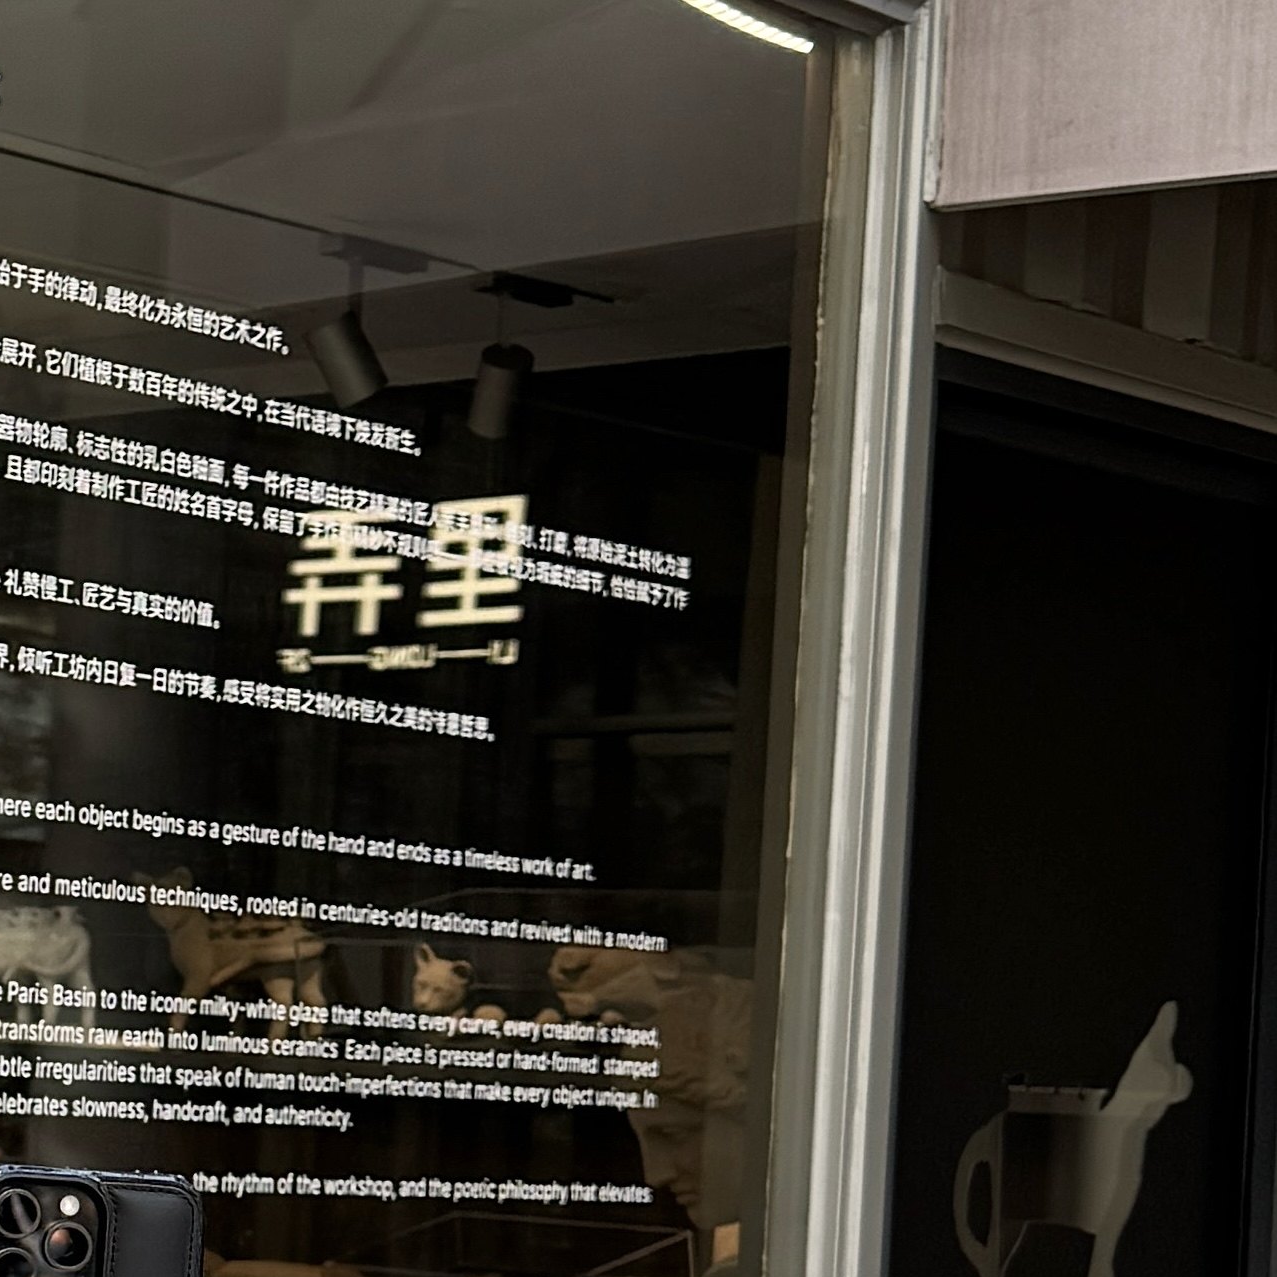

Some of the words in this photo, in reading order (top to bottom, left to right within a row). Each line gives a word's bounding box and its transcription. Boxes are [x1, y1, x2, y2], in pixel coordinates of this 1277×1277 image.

[35, 800, 74, 822] each
[79, 804, 128, 831] object
[133, 809, 184, 838] begins
[188, 820, 206, 838] as
[210, 822, 219, 839] a
[223, 823, 279, 846] gesture
[283, 826, 299, 847] of
[302, 828, 325, 851] the
[328, 832, 365, 855] hand
[367, 839, 394, 858] and
[397, 842, 431, 863] ends
[434, 848, 450, 865] as
[453, 850, 462, 867] a
[465, 848, 519, 873] timeless
[522, 857, 553, 876] work
[556, 858, 571, 878] of
[572, 863, 596, 881] art.
[18, 873, 50, 894] and
[55, 876, 145, 902] meticulous
[150, 884, 242, 916] techniques,
[247, 896, 298, 917] rooted
[301, 897, 315, 918] in
[320, 903, 418, 929] centuries-old
[421, 911, 488, 936] traditions
[491, 920, 517, 939] and
[520, 921, 571, 943] revived
[573, 926, 603, 946] with
[604, 932, 613, 948] a
[615, 932, 668, 952] modern
[8, 980, 48, 1006] Paris
[53, 983, 96, 1008] Basin
[101, 989, 117, 1010] to
[121, 989, 147, 1012] the
[151, 991, 196, 1015] iconic
[200, 995, 287, 1023] milky-white
[289, 1001, 328, 1027] glaze
[332, 1005, 361, 1026] that
[364, 1006, 415, 1030] softens
[419, 1014, 458, 1037] every
[459, 1017, 500, 1039] curve,
[503, 1020, 540, 1043] every
[543, 1021, 594, 1041] creation
[596, 1022, 608, 1043] is
[89, 1027, 118, 1046] raw
[123, 1028, 164, 1049] earth
[168, 1027, 198, 1051] into
[202, 1030, 269, 1055] luminous
[345, 1038, 380, 1061] Each
[383, 1041, 422, 1066] piece
[425, 1043, 437, 1065] is
[439, 1049, 494, 1069] pressed
[497, 1052, 511, 1069] or
[35, 1056, 136, 1085] irregularities
[140, 1062, 171, 1085] that
[176, 1066, 221, 1090] speak
[225, 1066, 242, 1088] of
[245, 1067, 294, 1090] human
[444, 1079, 472, 1100] that
[475, 1082, 511, 1102] make
[513, 1086, 550, 1108] every
[553, 1084, 593, 1108] object
[643, 1089, 656, 1108] In
[72, 1096, 148, 1123] slowness,
[153, 1098, 229, 1125] handcraft,
[234, 1103, 262, 1124] and
[193, 1171, 218, 1193] the
[222, 1172, 274, 1198] rhythm
[277, 1172, 293, 1194] of
[297, 1175, 321, 1195] the
[324, 1175, 396, 1201] workshop,
[399, 1178, 426, 1198] and
[429, 1178, 451, 1198] the
[453, 1178, 496, 1202] poetic
[499, 1180, 568, 1205] philosophy
[571, 1182, 597, 1202] that
